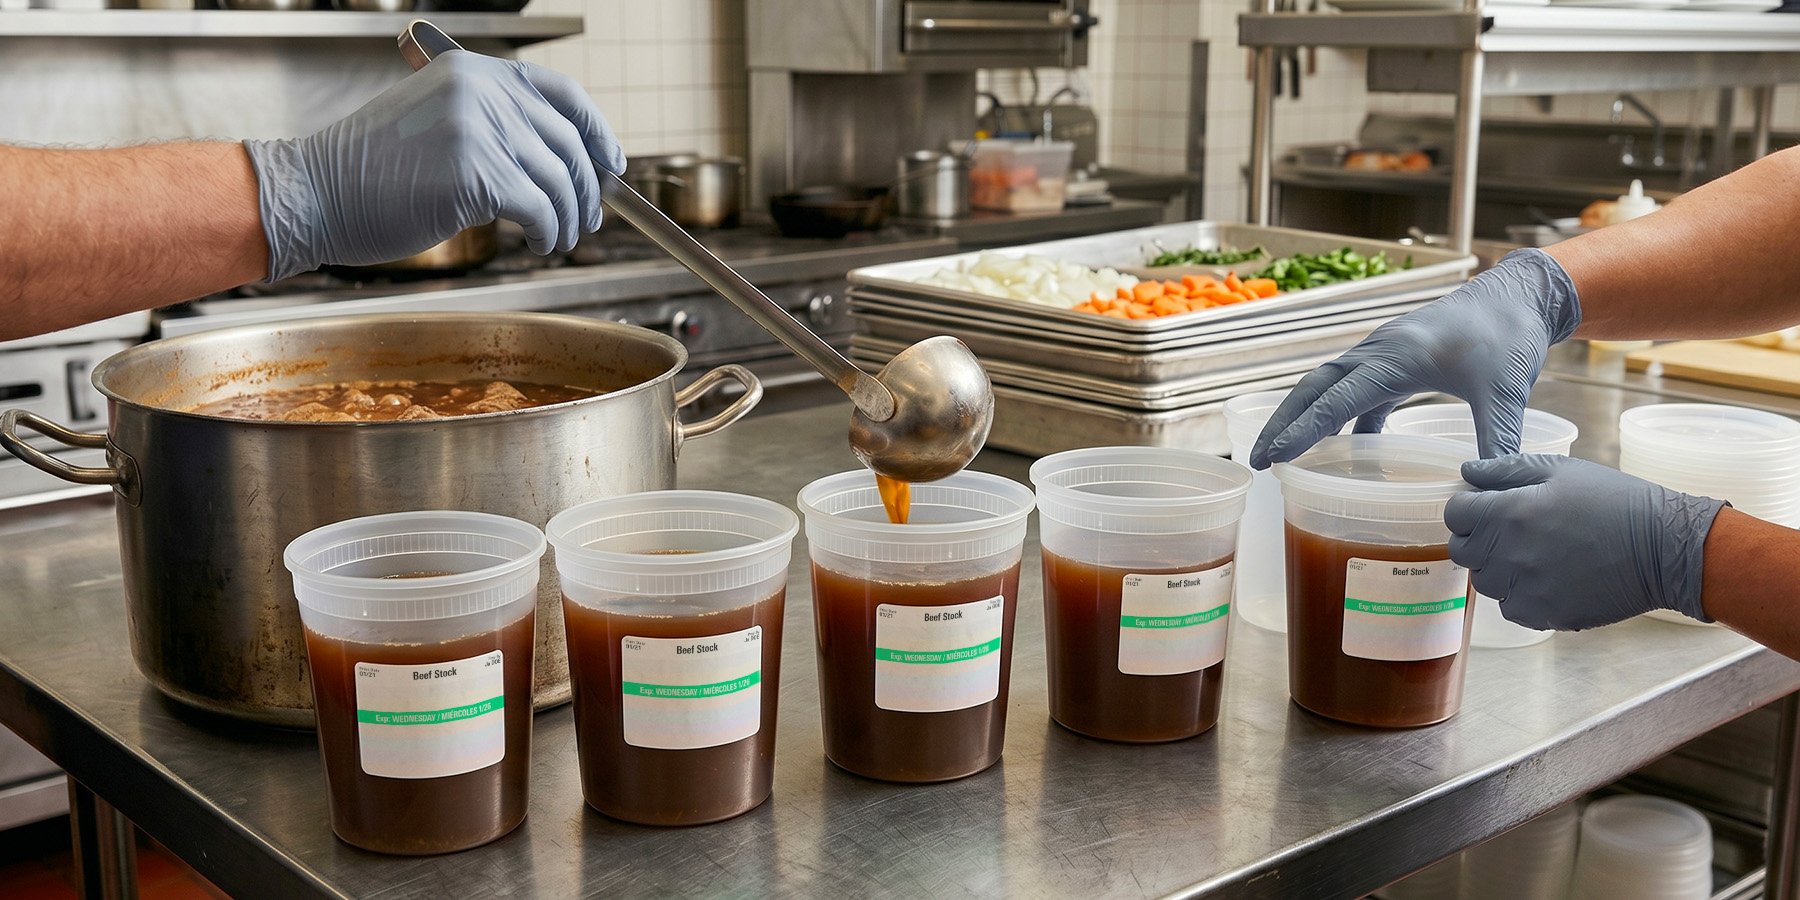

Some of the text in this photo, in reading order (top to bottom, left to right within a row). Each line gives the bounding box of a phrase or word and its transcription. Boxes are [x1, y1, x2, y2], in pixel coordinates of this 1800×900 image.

[1392, 567, 1430, 576] Beef Stock
[1167, 578, 1201, 589] Beef Stock
[1358, 602, 1370, 611] Exp:
[1371, 605, 1408, 613] WEDNESDAY
[924, 610, 963, 622] Beef Stock
[1135, 619, 1147, 627] Exp:
[1148, 619, 1181, 627] WEDNESDAY
[676, 642, 718, 655] Beef Stock
[890, 652, 903, 661] Exp:
[904, 653, 941, 662] WEDNESDAY
[413, 667, 457, 680] Beef Stock
[640, 686, 654, 695] Exp:
[655, 687, 698, 696] WEDNESDAY
[703, 683, 738, 695] MIÉRCOLES
[375, 714, 391, 723] Exp:
[392, 714, 436, 723] WEDNESDAY
[441, 707, 478, 720] MIÉRCOLES
